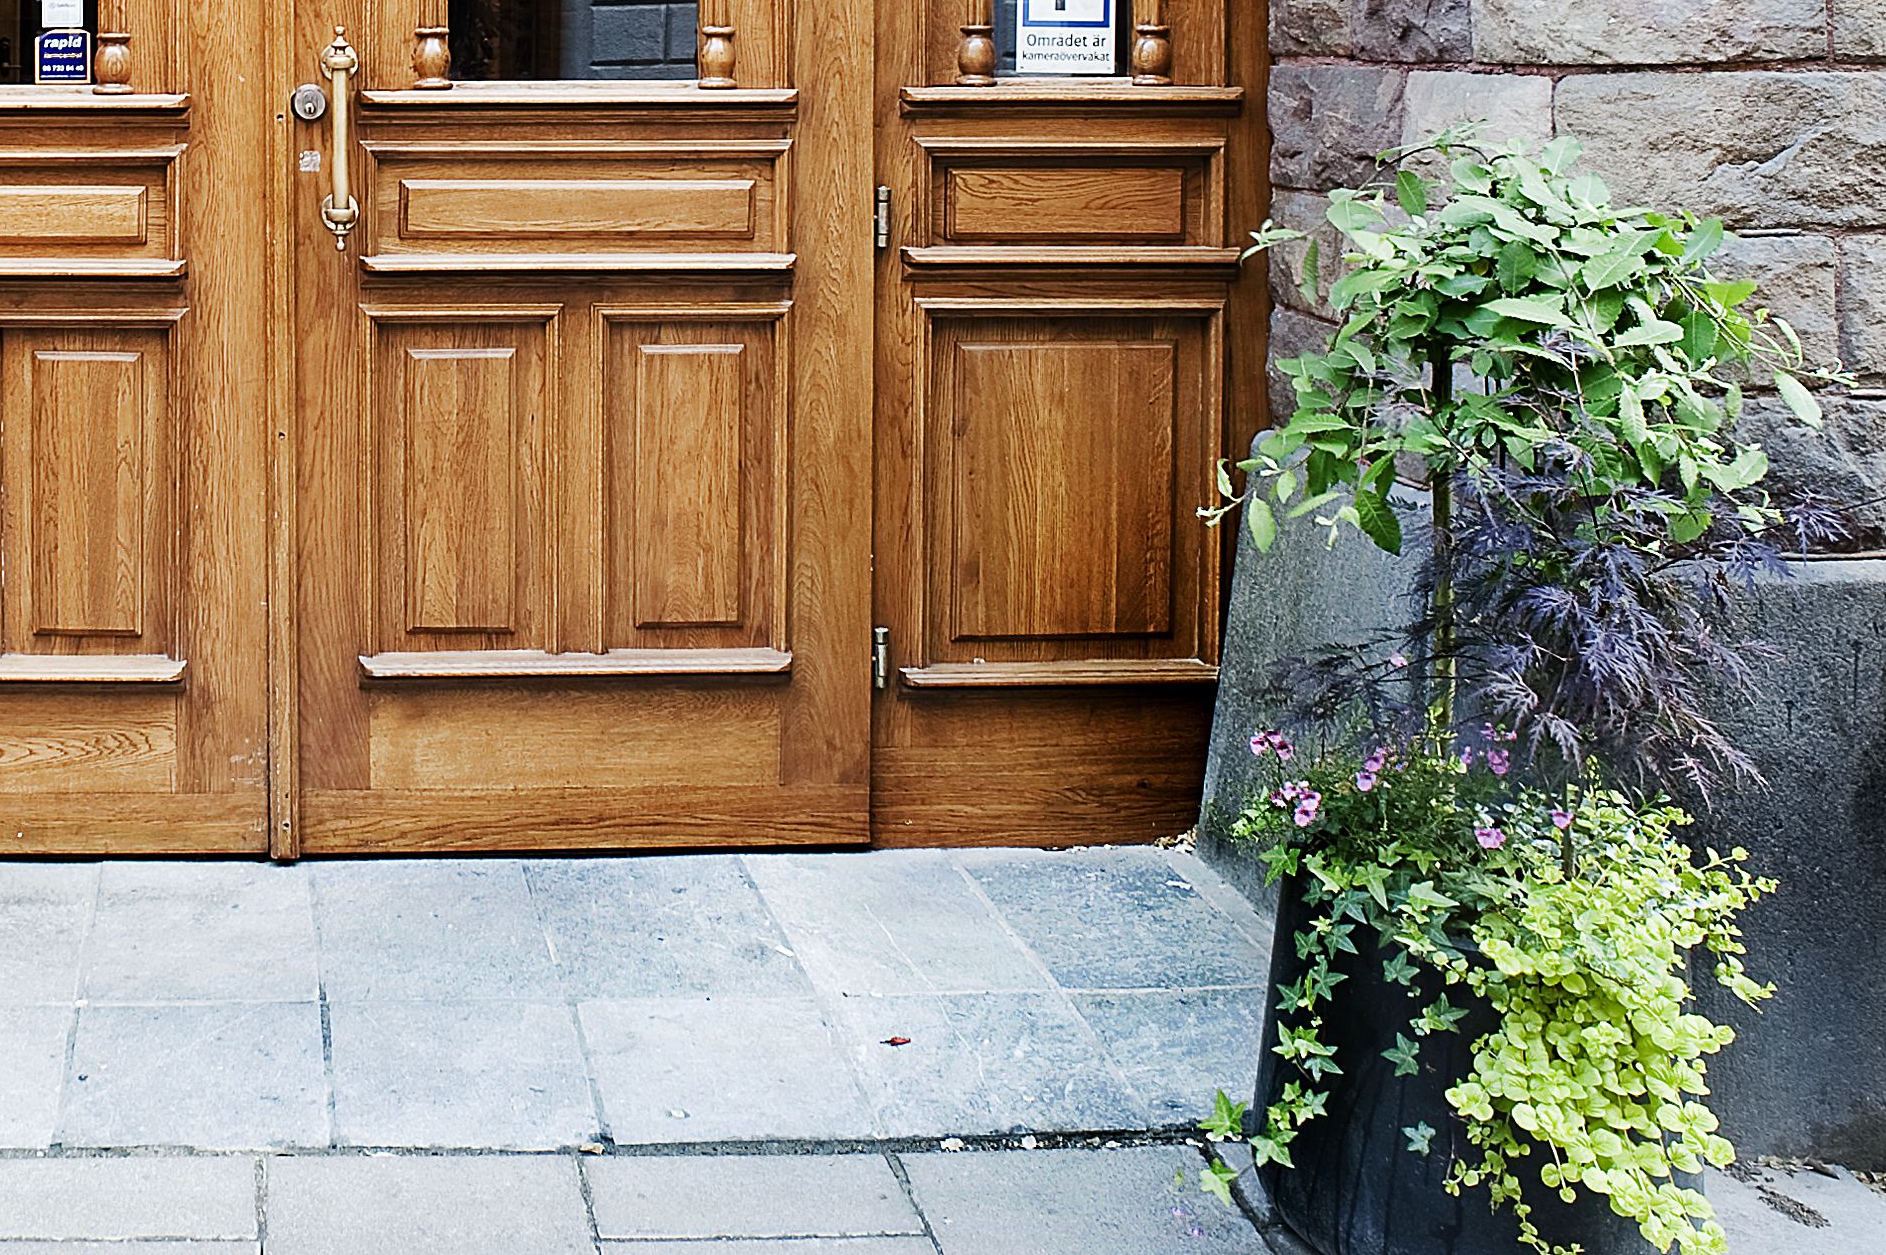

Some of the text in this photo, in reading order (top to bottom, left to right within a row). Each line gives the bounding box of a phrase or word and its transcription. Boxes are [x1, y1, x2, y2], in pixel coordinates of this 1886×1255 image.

[43, 35, 83, 50] rapid
[1026, 33, 1106, 47] Området är
[1022, 50, 1110, 62] kameraövervakat
